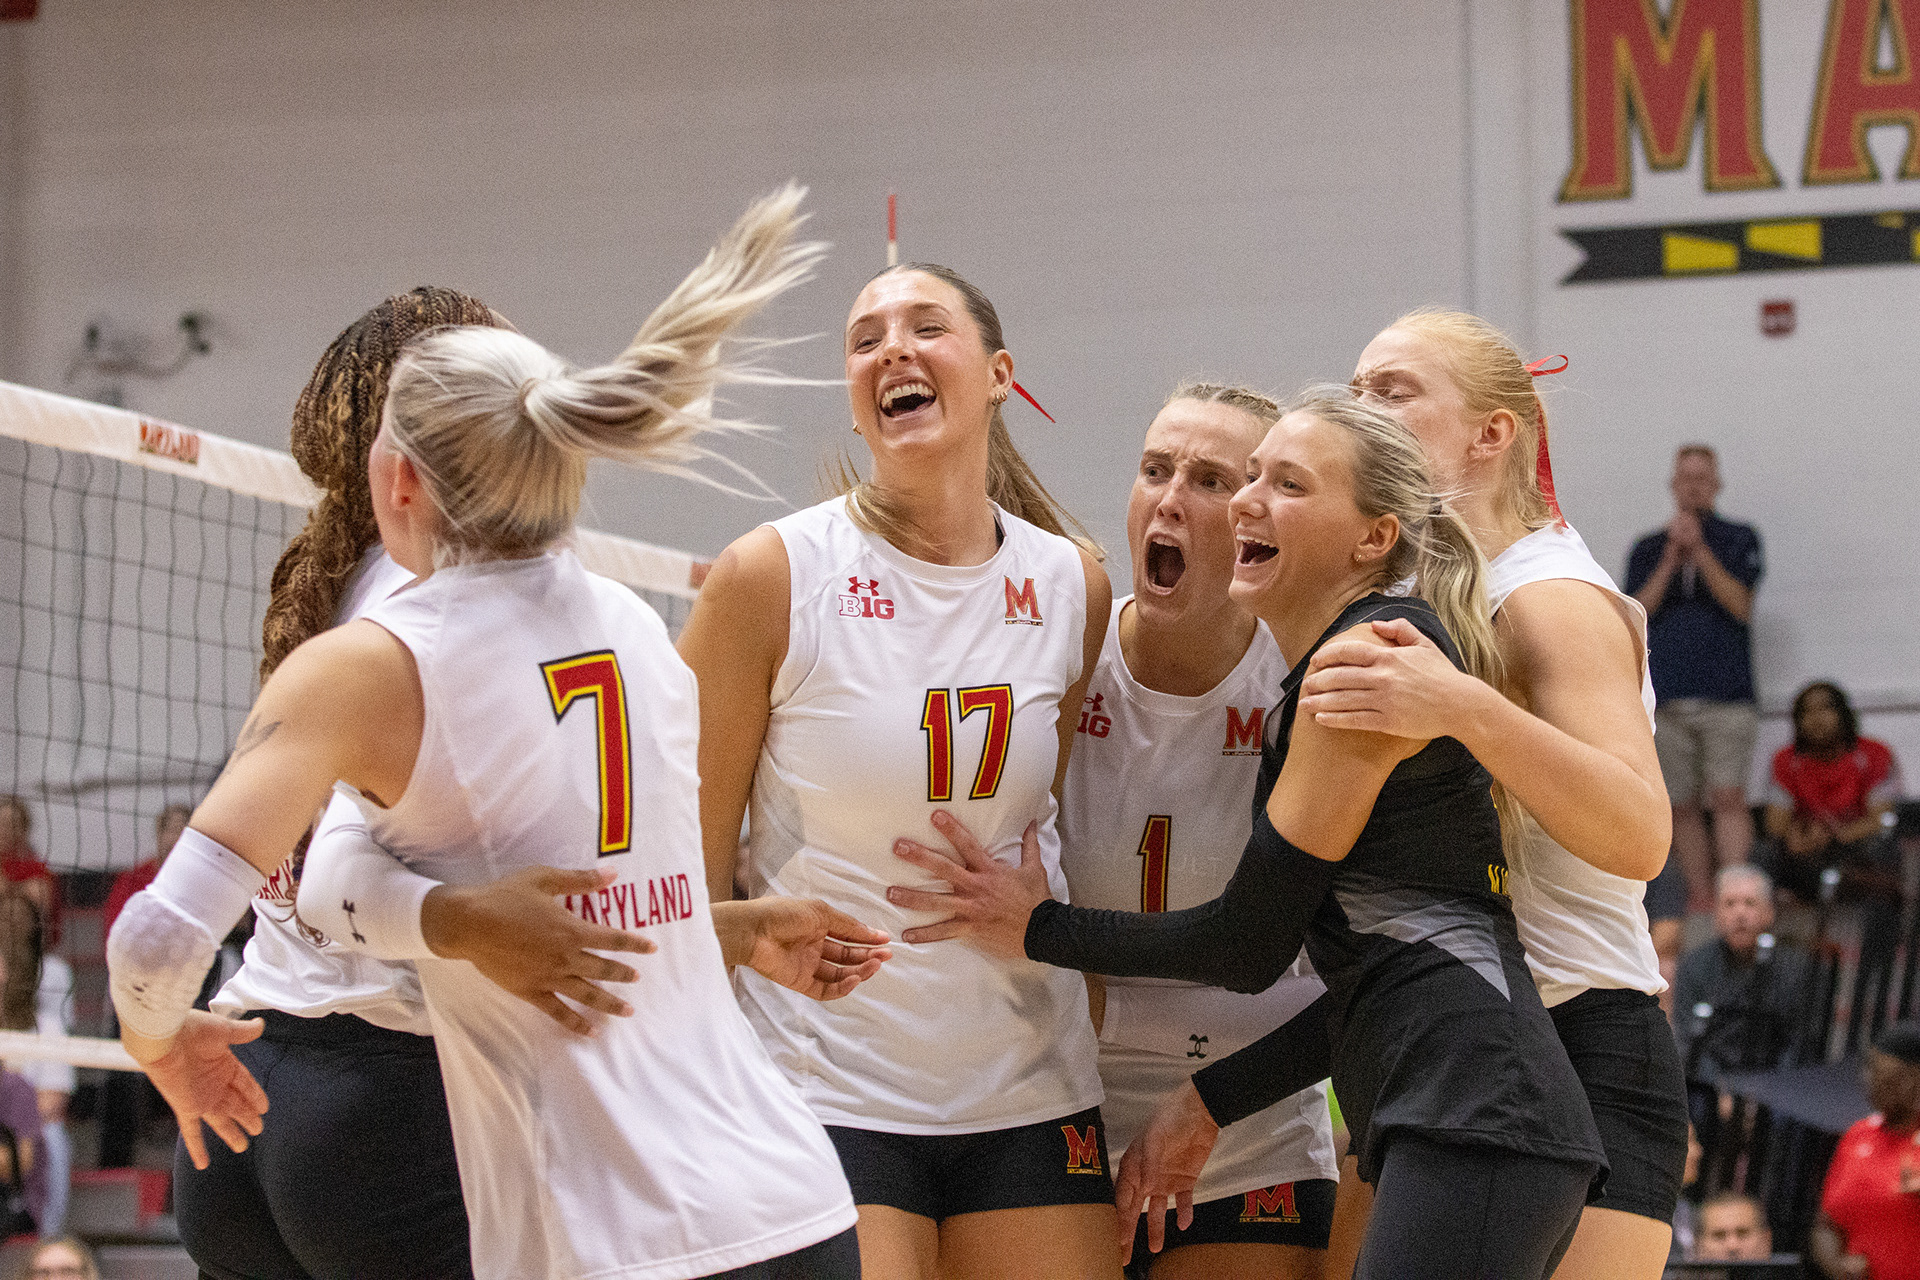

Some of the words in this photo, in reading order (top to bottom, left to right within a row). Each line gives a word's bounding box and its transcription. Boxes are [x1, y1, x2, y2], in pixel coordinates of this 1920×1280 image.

[1004, 575, 1044, 620] M
[919, 683, 1014, 802] 17
[1076, 711, 1112, 739] 1G
[1222, 705, 1267, 750] M
[538, 648, 633, 859] 7
[1136, 814, 1172, 913] 1
[565, 873, 693, 931] ARYLAND
[1061, 1124, 1102, 1169] M
